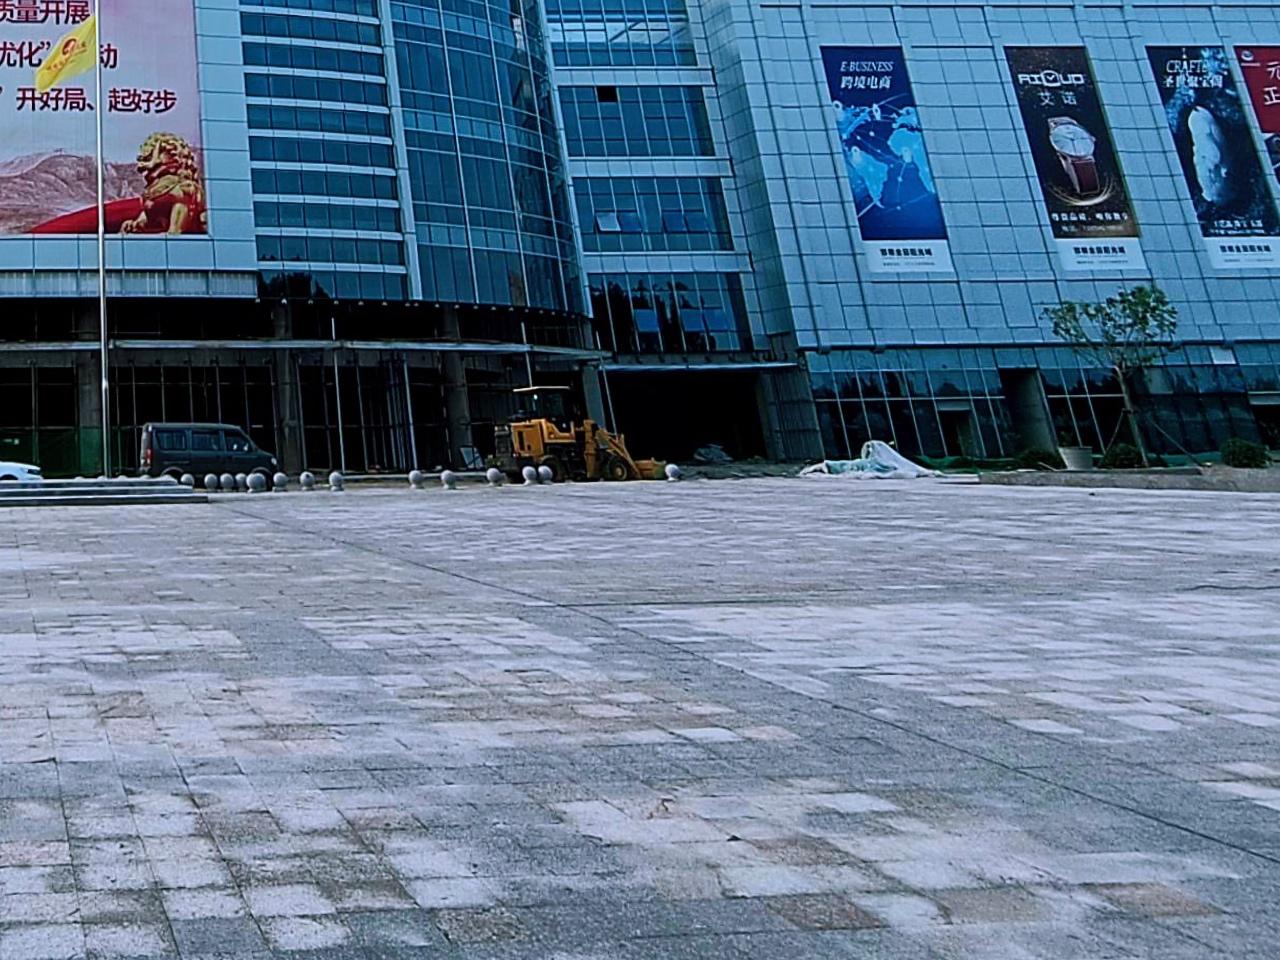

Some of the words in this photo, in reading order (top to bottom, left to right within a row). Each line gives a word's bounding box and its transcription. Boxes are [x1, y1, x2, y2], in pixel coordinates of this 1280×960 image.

[840, 61, 894, 72] E-BUSINESS
[840, 76, 892, 89] 跨境电商
